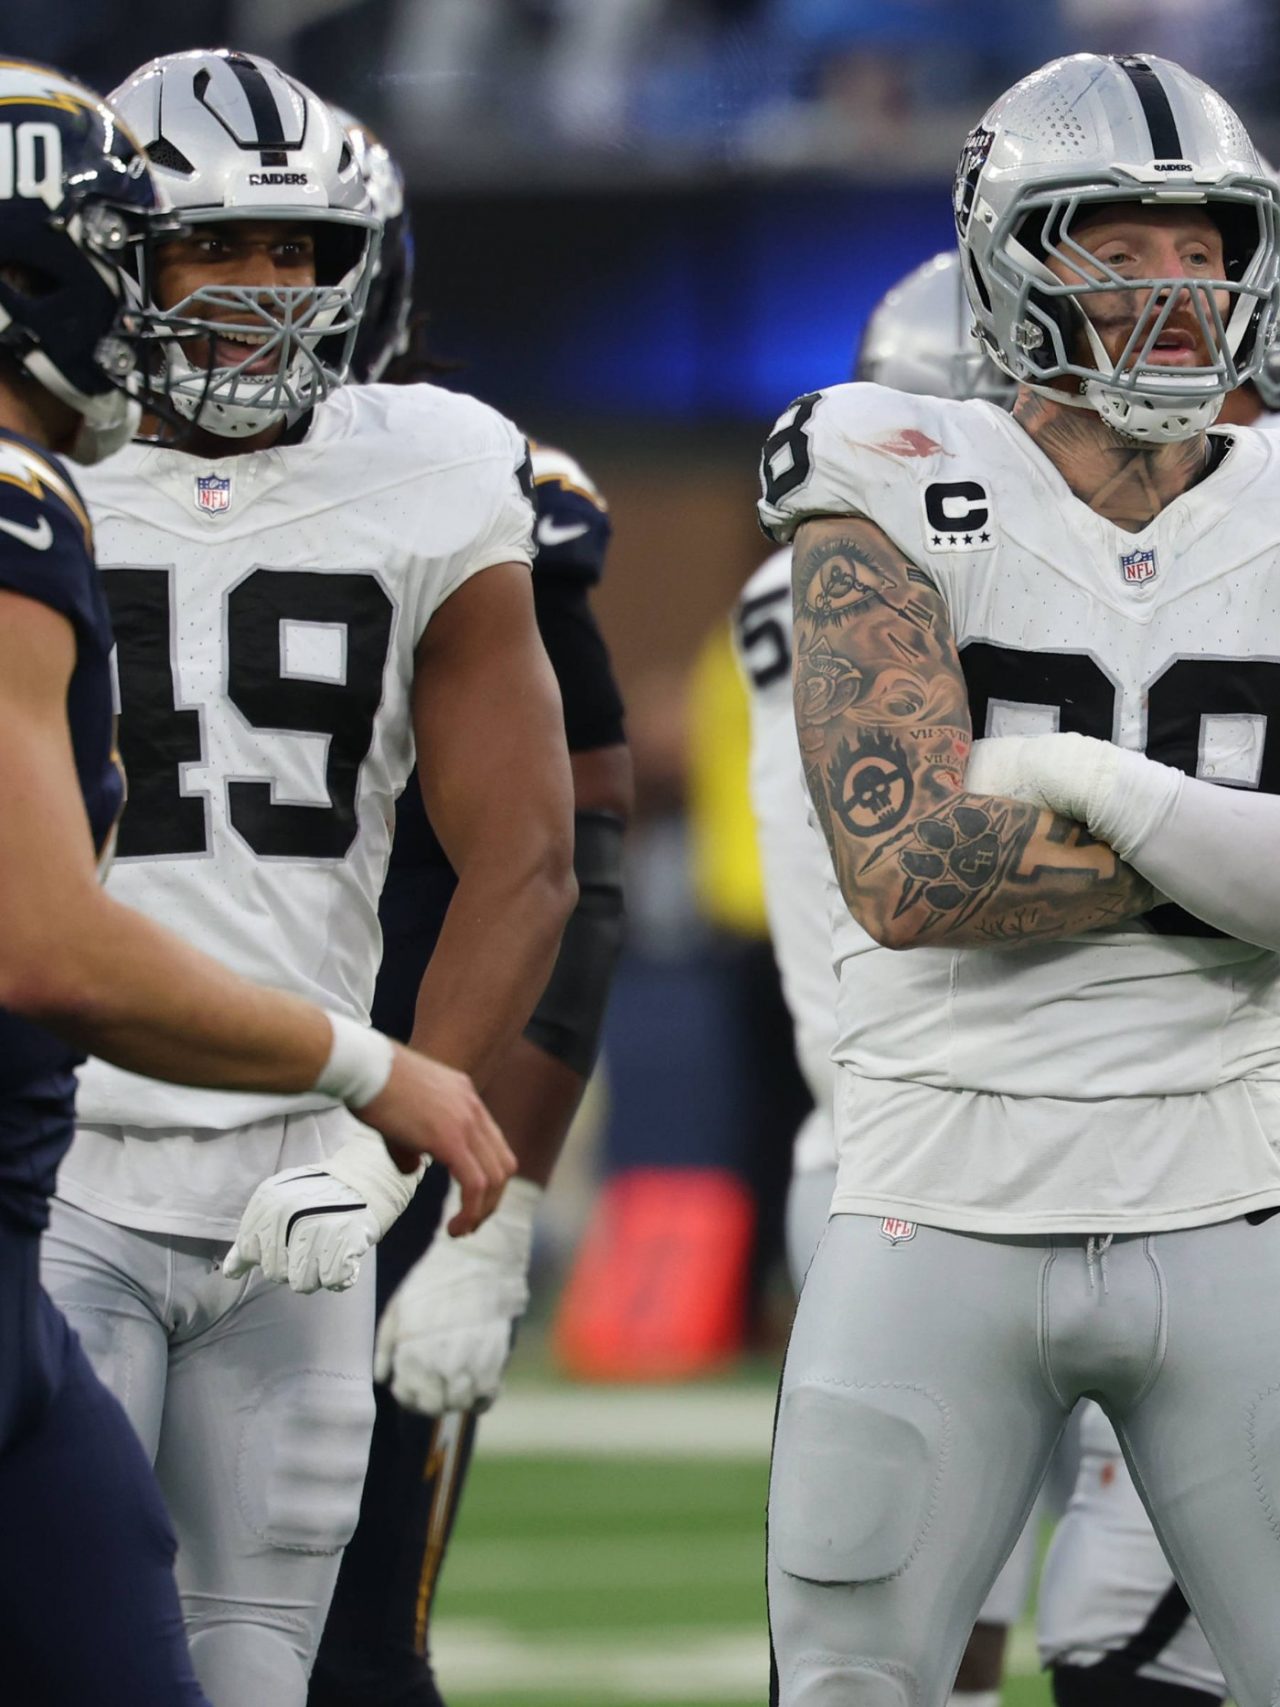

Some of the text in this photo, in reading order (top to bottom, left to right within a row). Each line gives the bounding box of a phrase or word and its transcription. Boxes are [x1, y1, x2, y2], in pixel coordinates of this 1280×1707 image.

[1153, 164, 1193, 172] RAIDERS
[248, 173, 308, 186] RAIDERS
[924, 480, 989, 533] C
[1126, 561, 1153, 580] NFL
